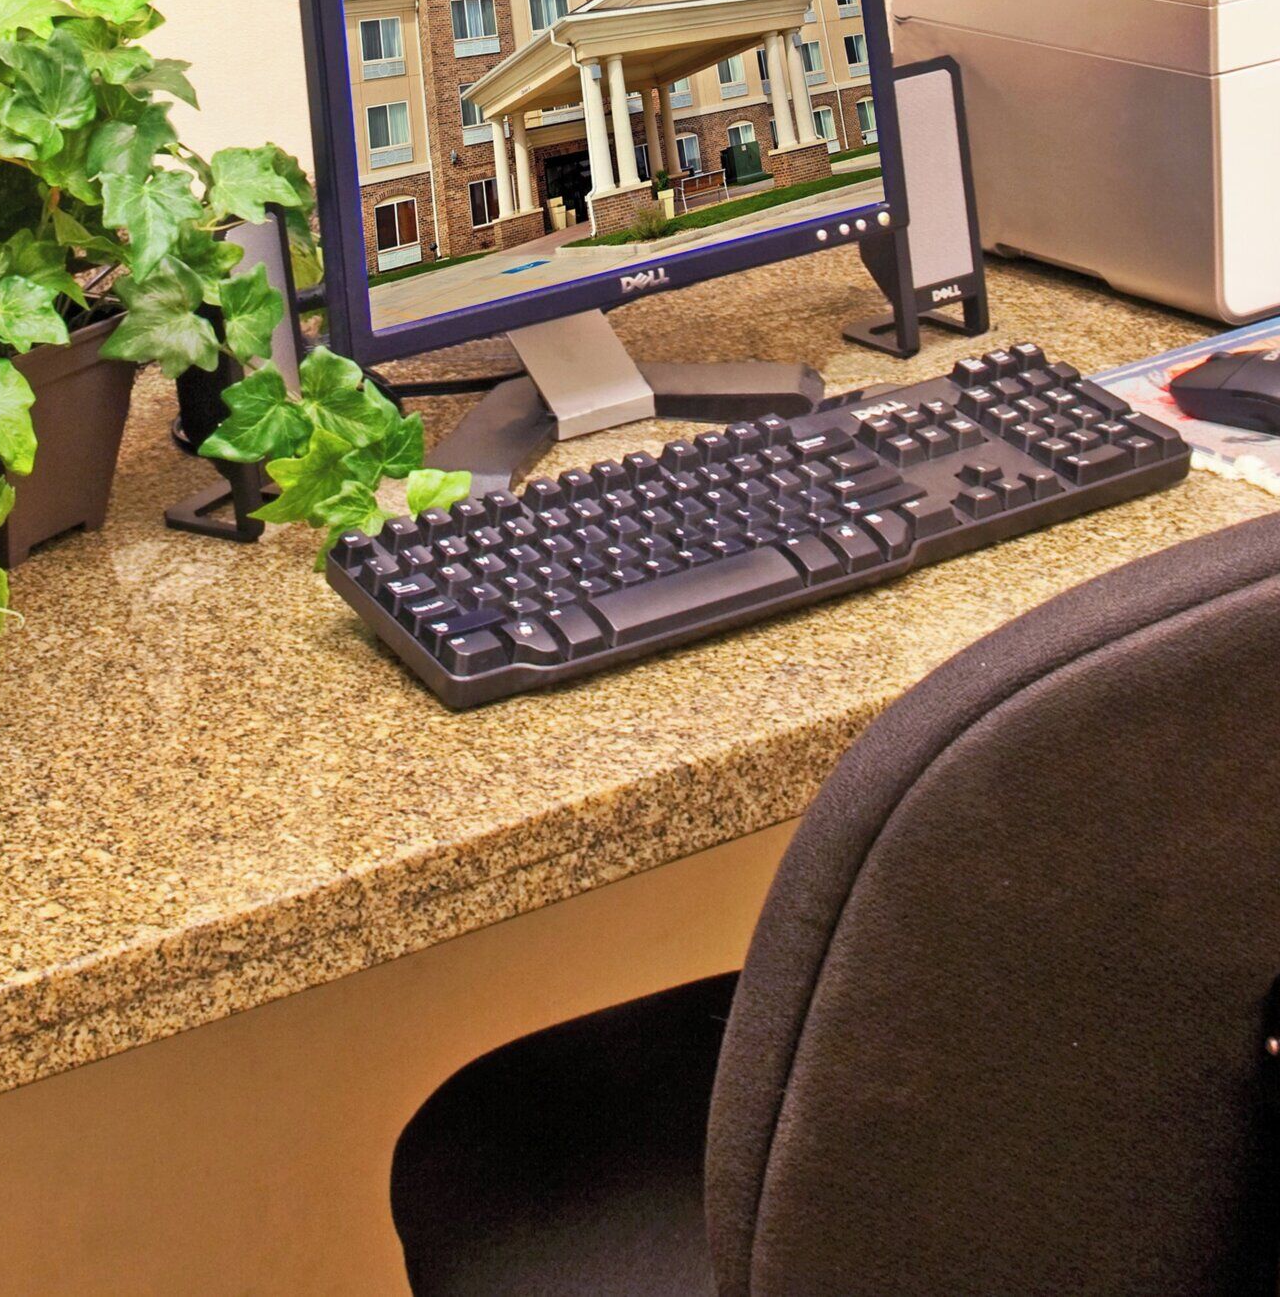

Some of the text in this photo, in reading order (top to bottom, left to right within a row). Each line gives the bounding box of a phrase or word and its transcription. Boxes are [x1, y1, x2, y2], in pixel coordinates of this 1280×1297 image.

[620, 267, 670, 293] DELL
[932, 284, 962, 302] DELL
[850, 400, 907, 421] DELL
